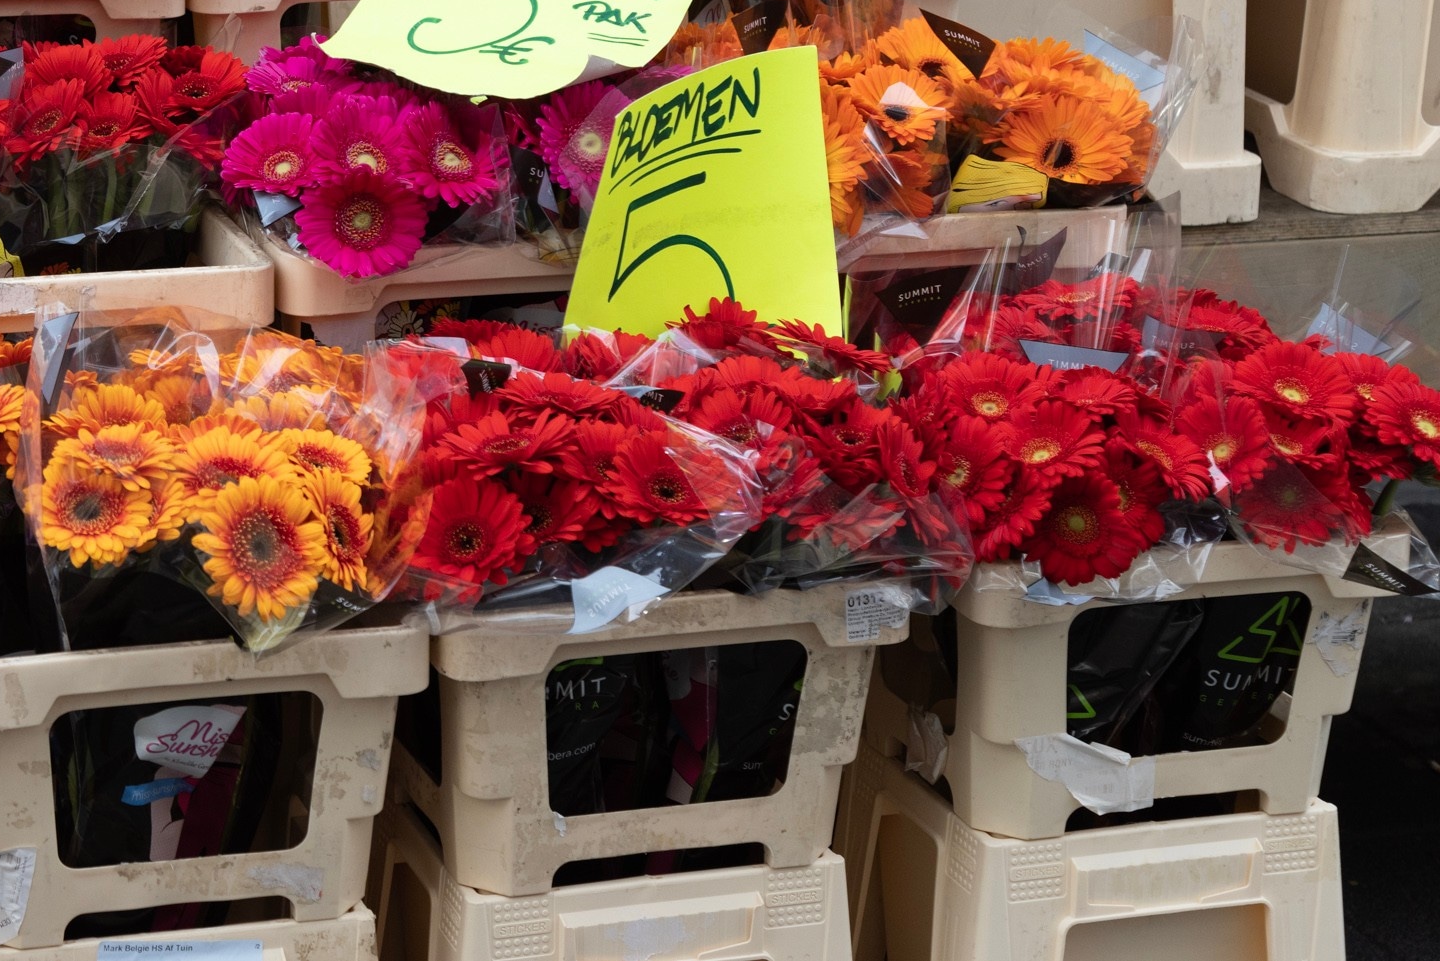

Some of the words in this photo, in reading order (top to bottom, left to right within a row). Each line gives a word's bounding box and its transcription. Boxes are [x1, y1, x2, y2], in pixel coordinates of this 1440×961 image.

[572, 0, 651, 34] PAK
[743, 16, 767, 34] SUMMIT
[944, 29, 981, 48] SUMMIT
[611, 68, 760, 179] BLOEMEN
[898, 284, 942, 302] SUMMIT
[1366, 563, 1406, 590] SUMMIT
[1204, 666, 1296, 691] SUMMI
[771, 890, 818, 905] STICKER
[499, 921, 546, 936] STICKER
[103, 944, 123, 952] Mark
[125, 944, 150, 954] Belgie
[151, 944, 163, 952] HS
[164, 944, 174, 952] Af
[175, 944, 193, 952] Tuin
